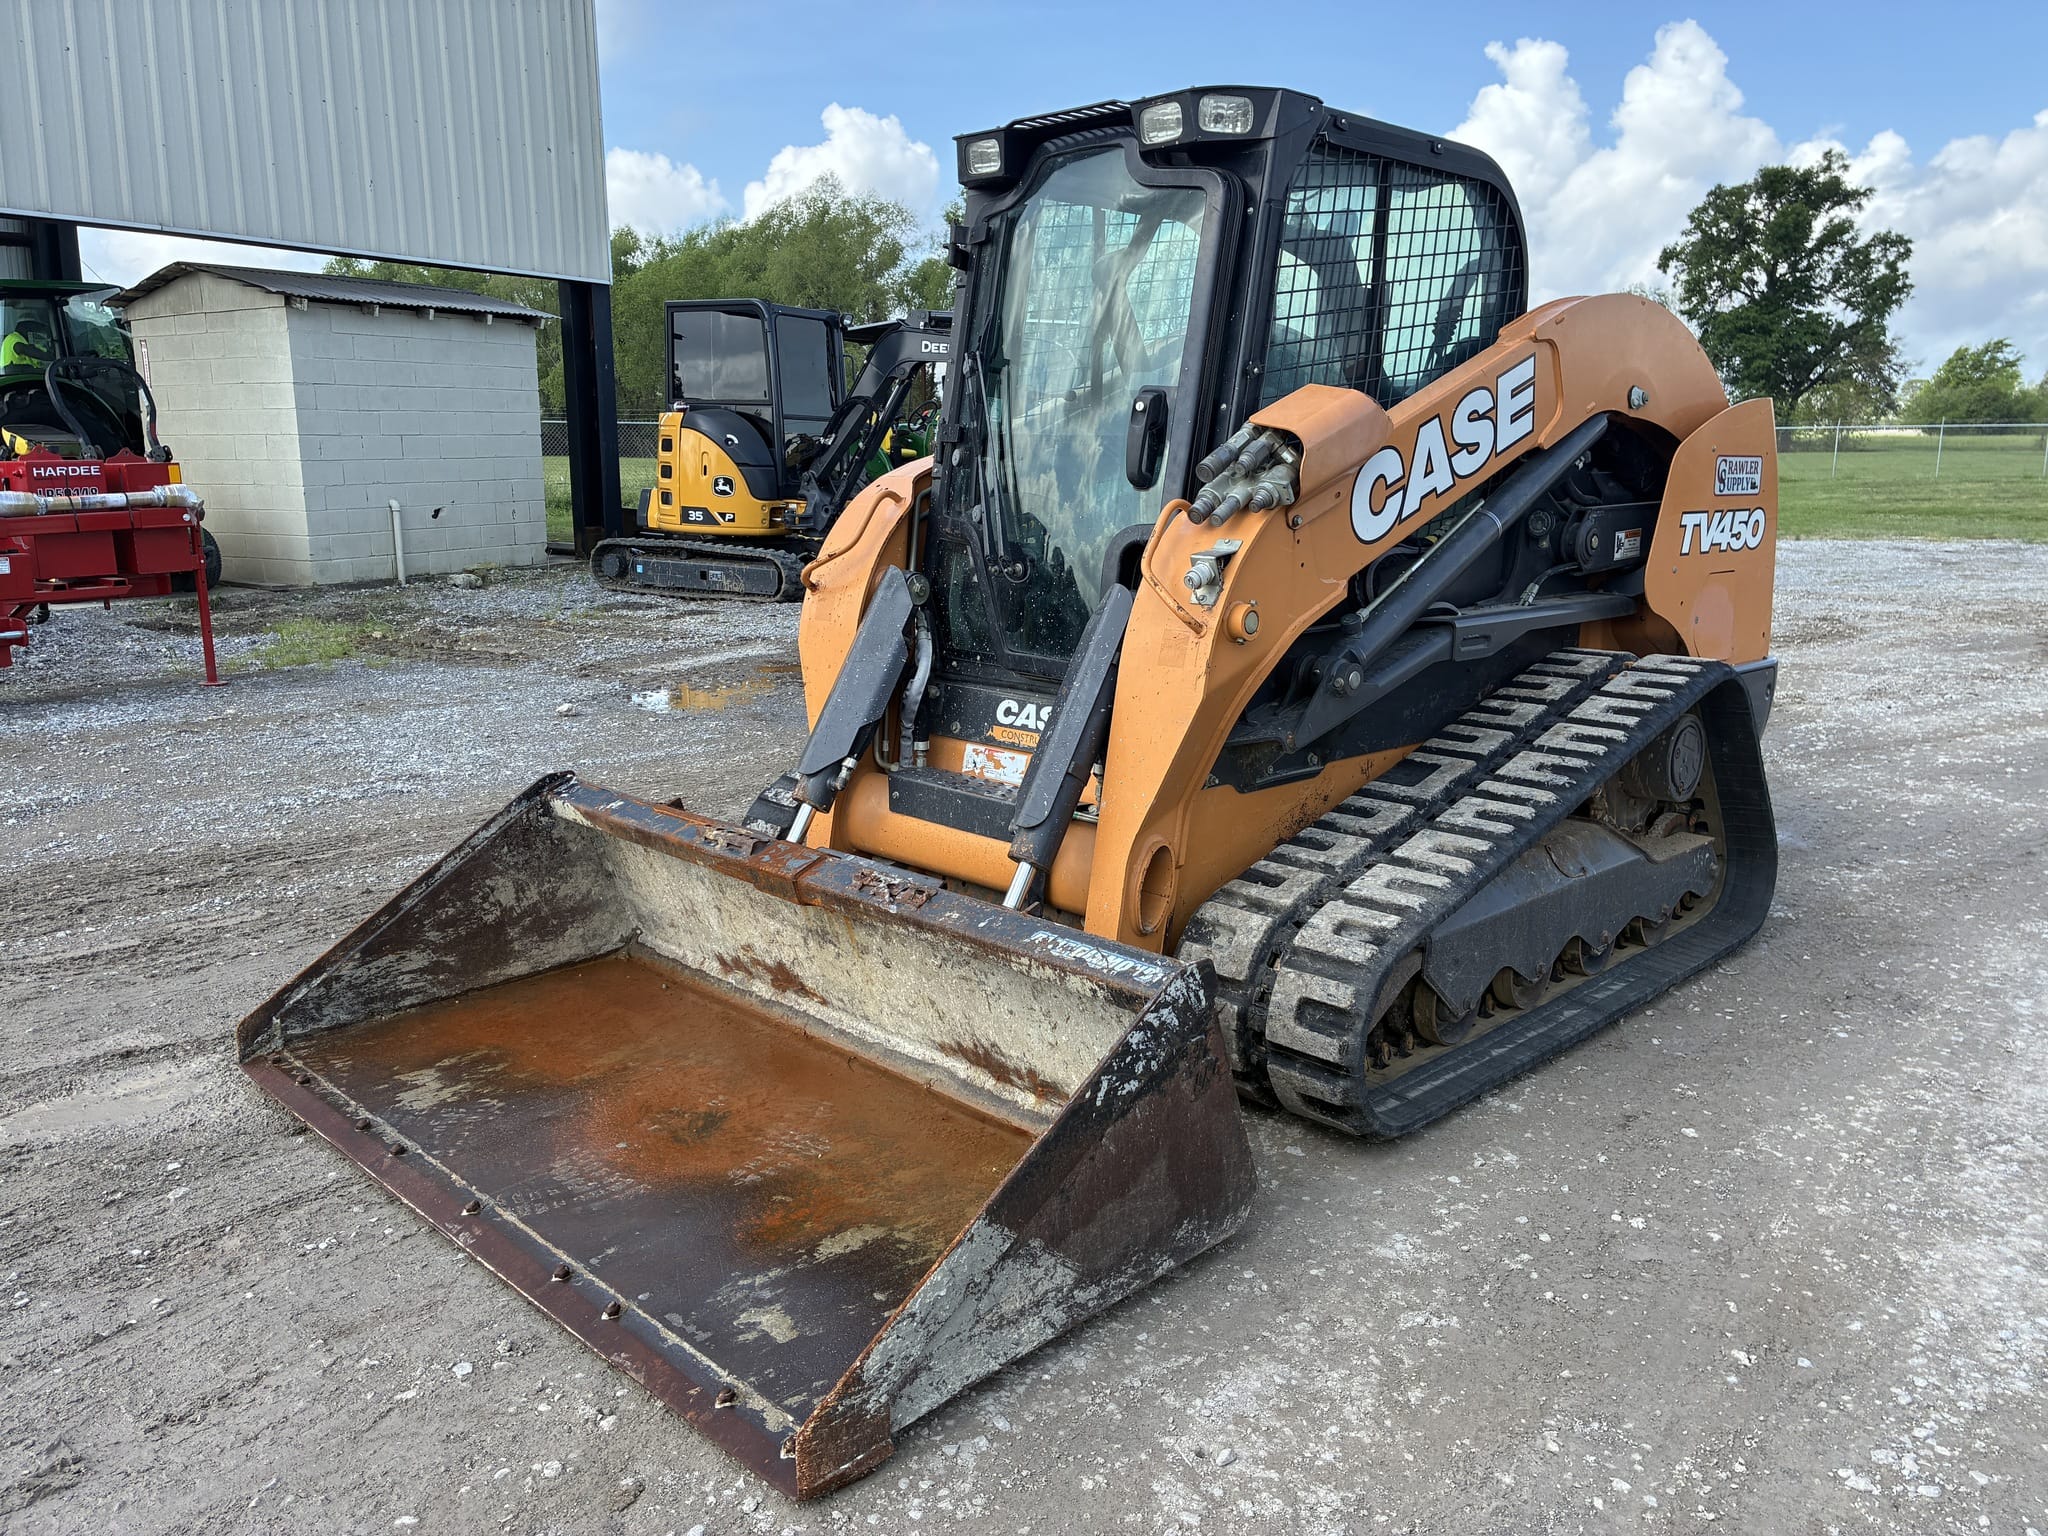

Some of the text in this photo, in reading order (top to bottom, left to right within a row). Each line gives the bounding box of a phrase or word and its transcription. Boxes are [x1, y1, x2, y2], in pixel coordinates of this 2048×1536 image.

[921, 340, 949, 353] DEE
[1351, 353, 1535, 543] CASE
[33, 465, 101, 477] HARDEE
[1717, 459, 1758, 482] CRAWLER
[1718, 471, 1750, 492] SUPPLY
[688, 511, 703, 521] 35
[1680, 507, 1766, 556] TV450
